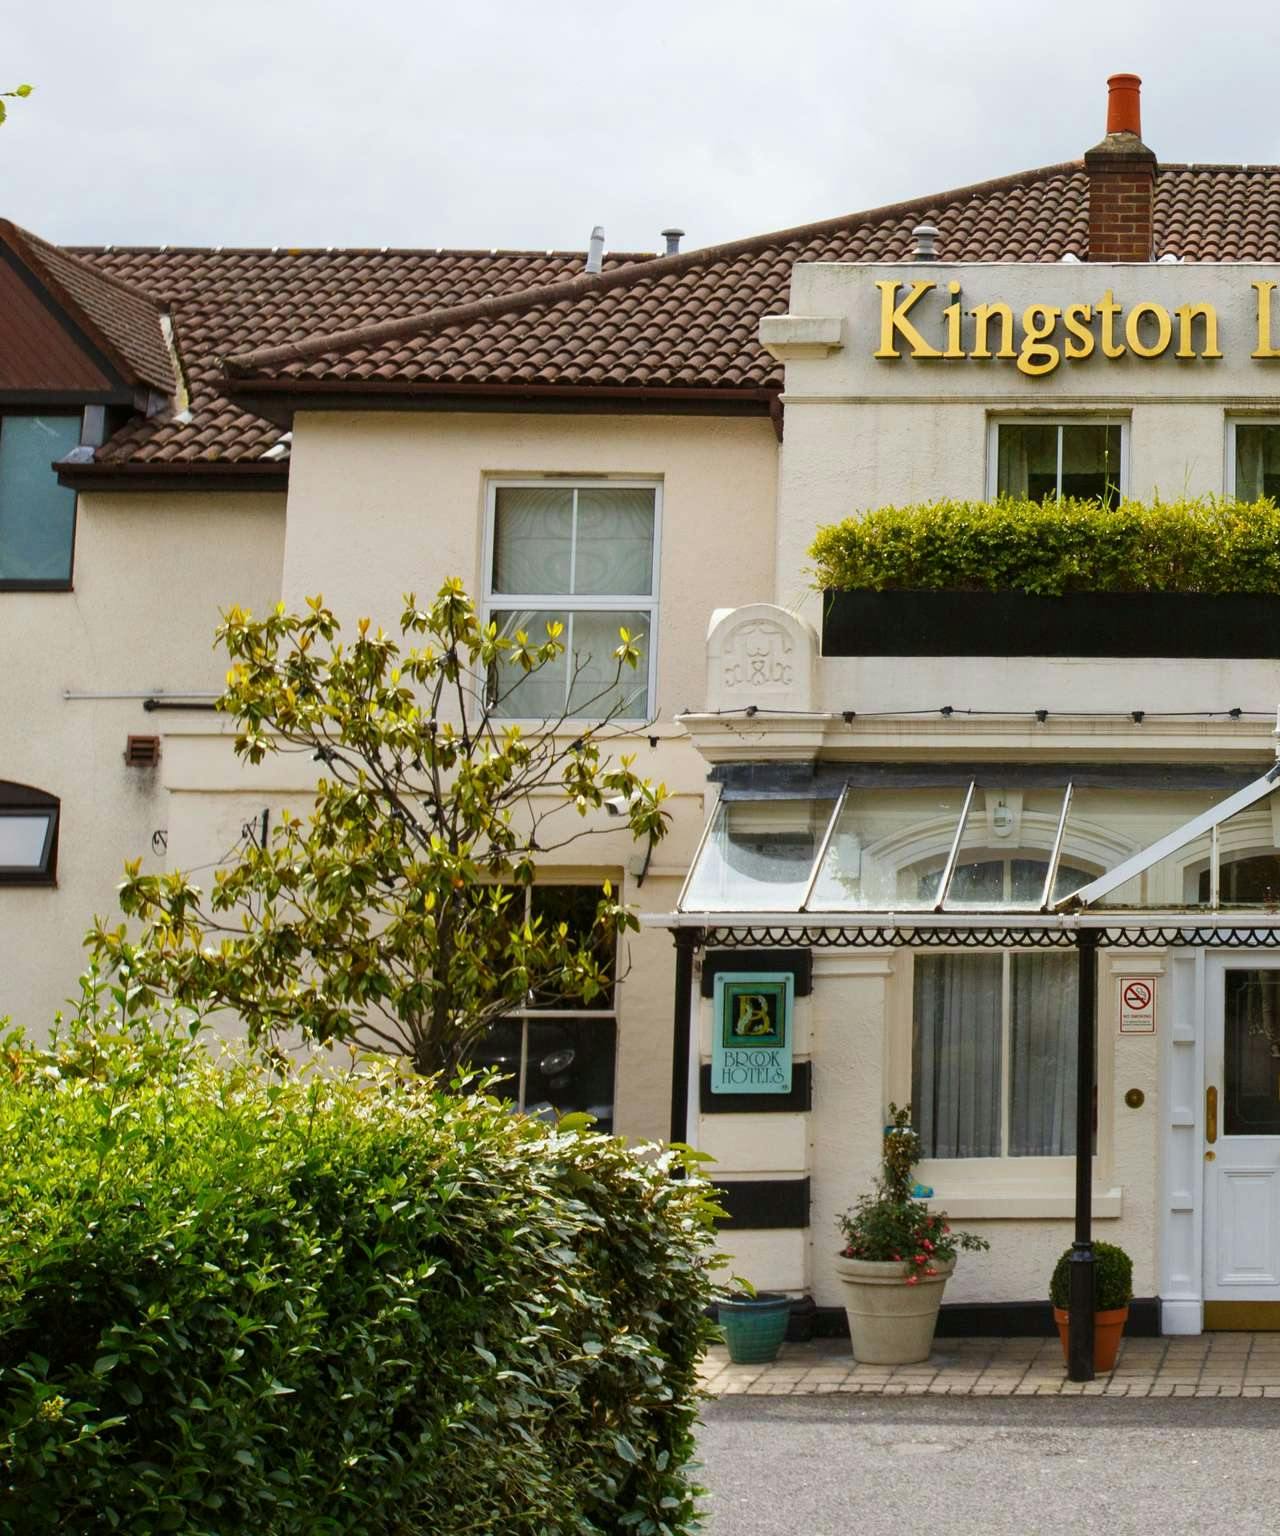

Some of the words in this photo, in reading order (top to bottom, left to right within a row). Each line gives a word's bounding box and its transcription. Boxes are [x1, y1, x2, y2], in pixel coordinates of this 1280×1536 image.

[873, 279, 1223, 376] Kingston
[724, 1051, 781, 1067] BROOK
[722, 1067, 785, 1084] HOTELS
